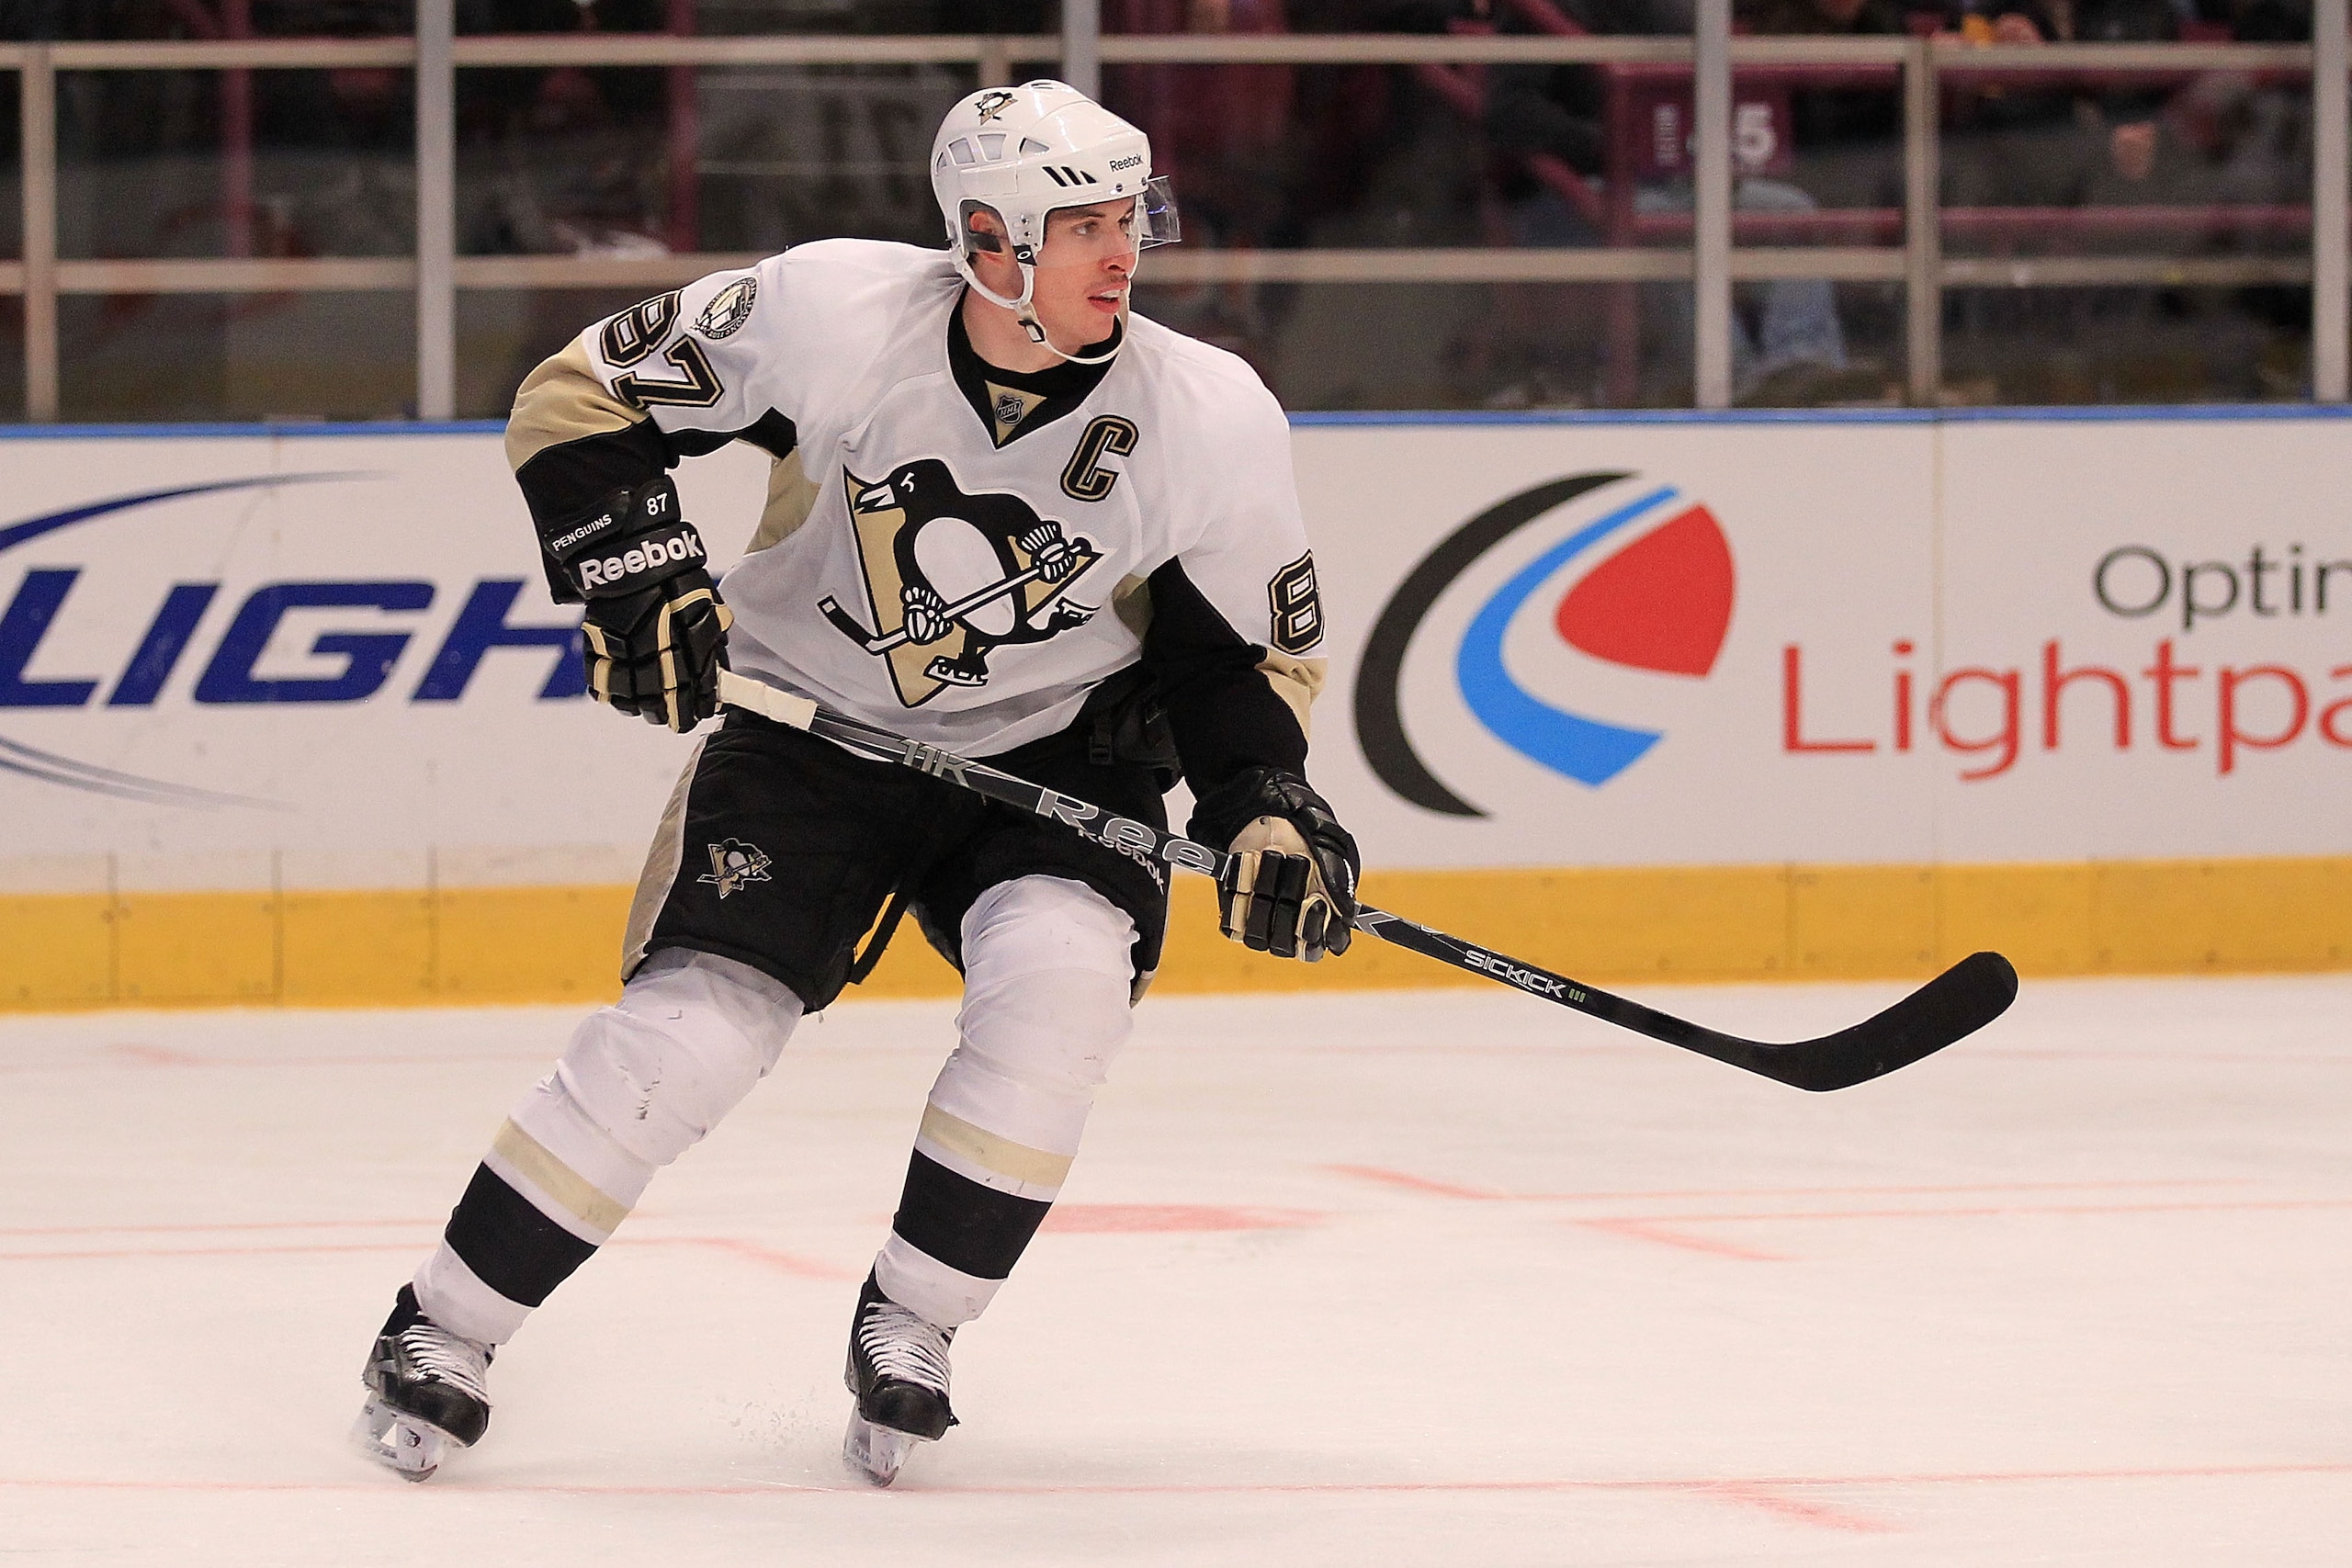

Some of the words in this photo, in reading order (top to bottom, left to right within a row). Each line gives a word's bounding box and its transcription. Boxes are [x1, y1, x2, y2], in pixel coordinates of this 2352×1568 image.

[1109, 153, 1144, 172] Reebok
[599, 289, 724, 410] 87
[1060, 414, 1139, 502] C
[552, 513, 612, 551] PENGUINS
[646, 493, 667, 515] 87
[579, 530, 704, 591] Reebok
[0, 568, 587, 707] LIGH
[1035, 787, 1232, 881] Ree
